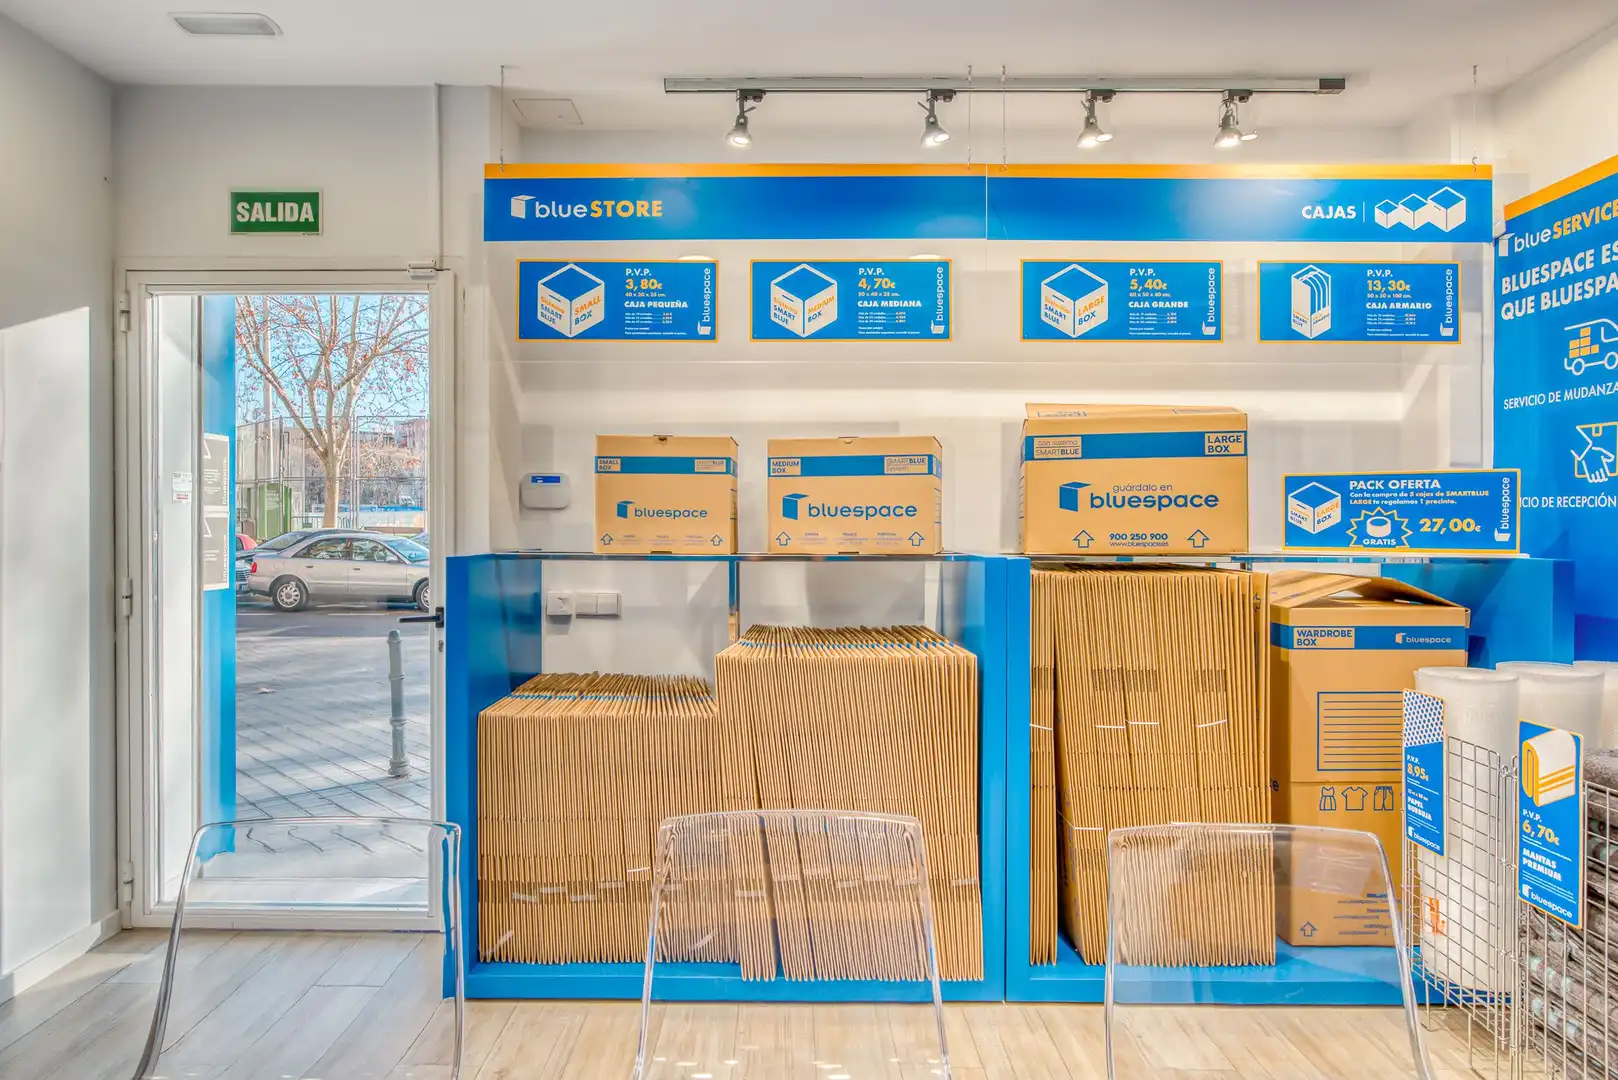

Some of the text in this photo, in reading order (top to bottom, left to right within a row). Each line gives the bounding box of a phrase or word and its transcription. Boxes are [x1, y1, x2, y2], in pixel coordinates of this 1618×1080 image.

[236, 201, 314, 222] SALIDA
[535, 200, 663, 218] blueSTORE
[1301, 205, 1356, 219] CAJAS
[625, 268, 652, 276] P.V.P.
[858, 267, 885, 275] P.V.P.
[1129, 268, 1156, 276] P.V.P.
[1367, 269, 1393, 277] P.V.P.
[1501, 249, 1594, 295] BLUESPACE
[702, 267, 711, 322] bluespace
[936, 266, 944, 321] bluespace
[1207, 267, 1216, 322] bluespace
[1444, 269, 1453, 324] bluespace
[1501, 272, 1618, 320] QUE BLUESPA
[574, 296, 601, 315] SMALL
[647, 300, 688, 308] PEQUEÑA
[808, 295, 835, 315] MEDIUM
[1077, 295, 1105, 316] LARGE
[1389, 302, 1432, 310] ARMARIO
[540, 304, 562, 320] SMART
[574, 309, 592, 325] BOX
[773, 304, 795, 320] SMART
[807, 310, 822, 323] BOX
[1044, 304, 1067, 320] SMART
[1044, 311, 1060, 325] BLUE
[1078, 310, 1096, 325] BOX
[1503, 393, 1545, 410] SERVICIO
[1548, 391, 1561, 403] DE
[1207, 435, 1242, 444] LARGE
[1035, 448, 1080, 456] SMARTBLUE
[1207, 445, 1230, 453] BOX
[1112, 483, 1158, 493] guárdalo
[1349, 479, 1441, 490] PACK OFERTA
[1090, 492, 1219, 511] bluespace
[1425, 498, 1457, 506] precinto.
[1500, 476, 1511, 530] bluespace
[1520, 492, 1617, 508] ICIO DE RECEPCIÓN
[634, 507, 708, 519] bluespace
[808, 503, 918, 520] bluespace
[1290, 510, 1308, 522] SMART
[1316, 501, 1340, 518] LARGE
[1316, 513, 1332, 525] BOX
[1419, 518, 1481, 535] 27,00€
[1109, 533, 1169, 541] 900 250 900
[1362, 538, 1397, 546] GRATIS
[1297, 630, 1352, 638] WARDROBE
[1405, 636, 1451, 644] bluespace
[1297, 638, 1317, 646] BOX
[1407, 796, 1423, 809] PAPEL
[1522, 809, 1543, 822] P.V.P.
[1413, 832, 1440, 850] bluespace
[1522, 848, 1557, 869] MANTAS
[1522, 857, 1562, 881] PREMIUM
[1531, 891, 1573, 918] bluespace
